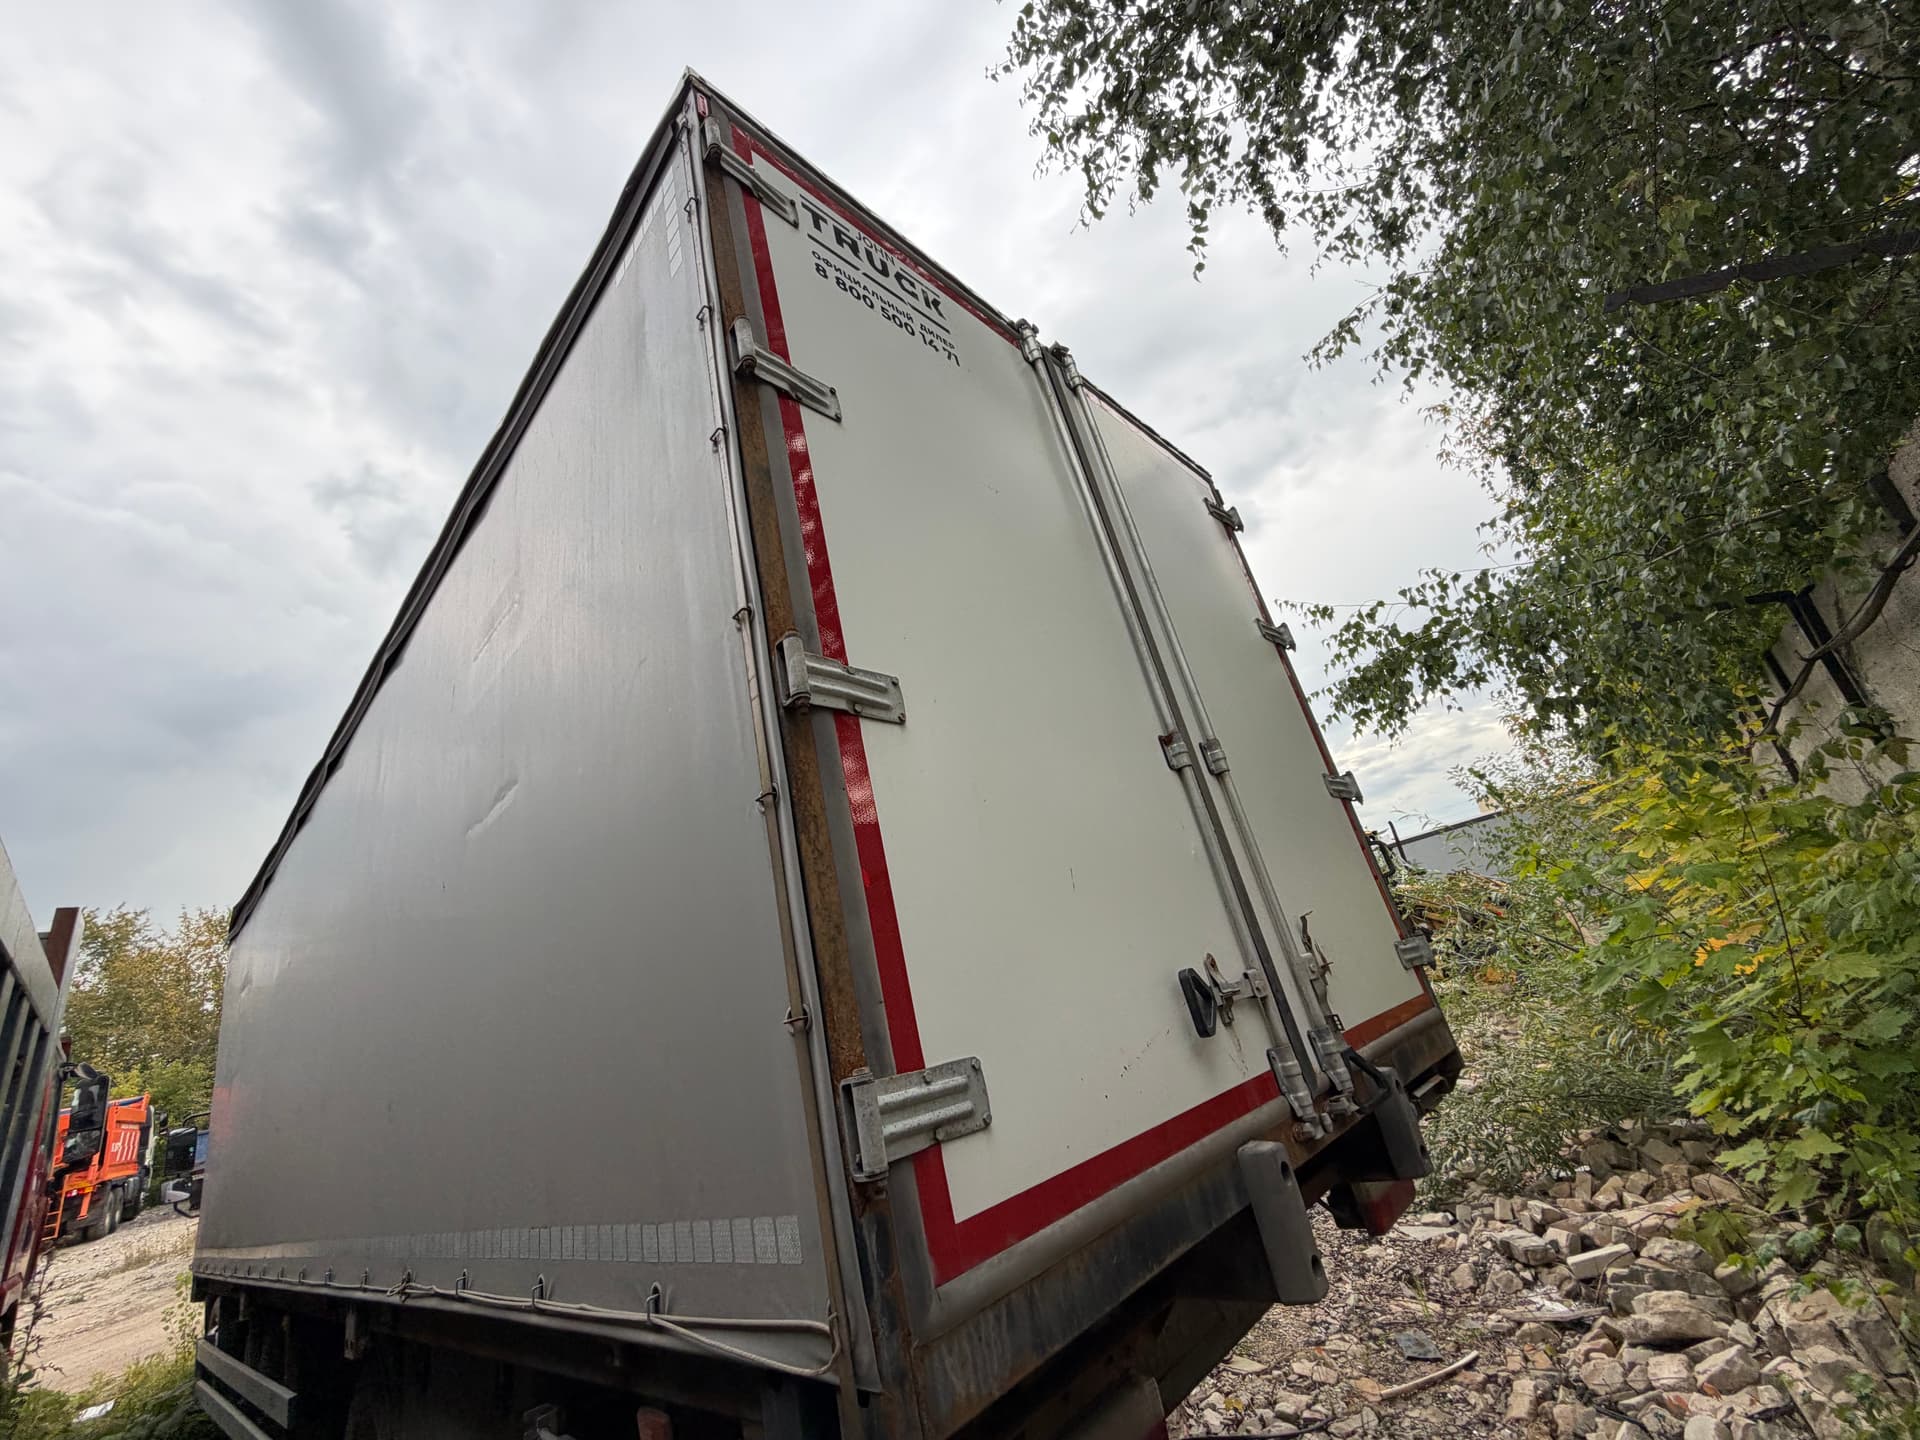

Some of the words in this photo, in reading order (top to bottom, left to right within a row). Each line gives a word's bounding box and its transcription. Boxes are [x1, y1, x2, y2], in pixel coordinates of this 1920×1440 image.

[800, 202, 947, 321] TRUCK
[856, 231, 896, 267] JOHN
[811, 250, 914, 323] ОФИЦИАЛЬНЫЙ
[919, 323, 955, 349] ДИЛЕР
[814, 262, 828, 279] 8
[835, 276, 875, 309] 800
[880, 305, 915, 336] 500
